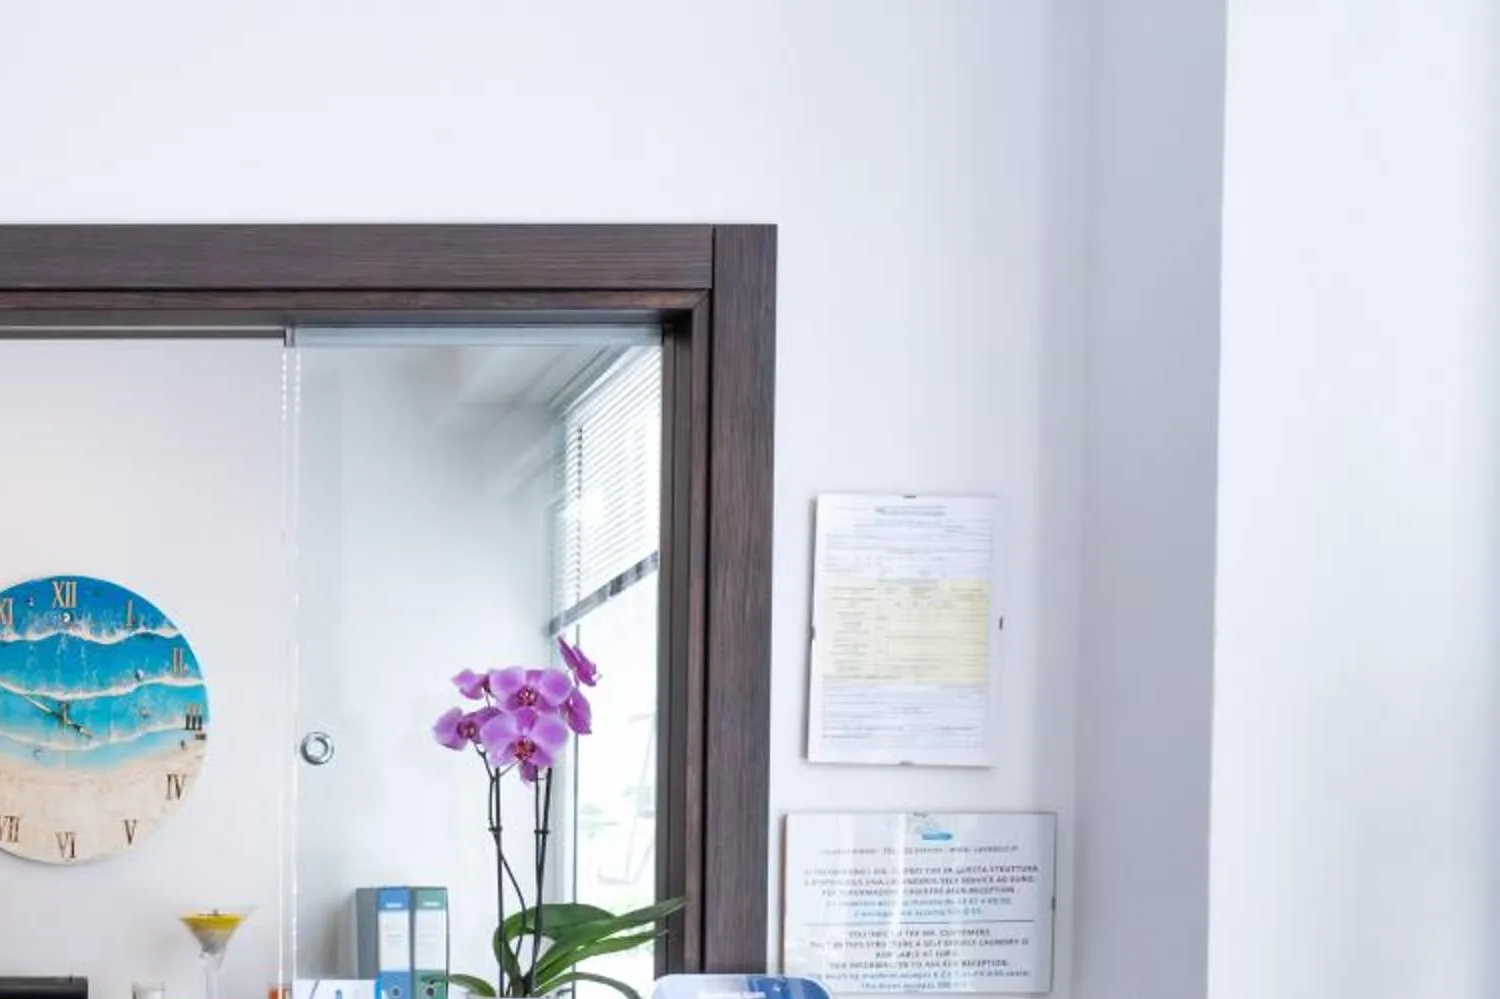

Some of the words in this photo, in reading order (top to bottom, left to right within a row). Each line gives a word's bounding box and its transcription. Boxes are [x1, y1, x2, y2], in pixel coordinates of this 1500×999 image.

[51, 580, 77, 609] XII
[166, 773, 187, 801] IV
[55, 831, 78, 859] VI
[124, 819, 138, 846] V
